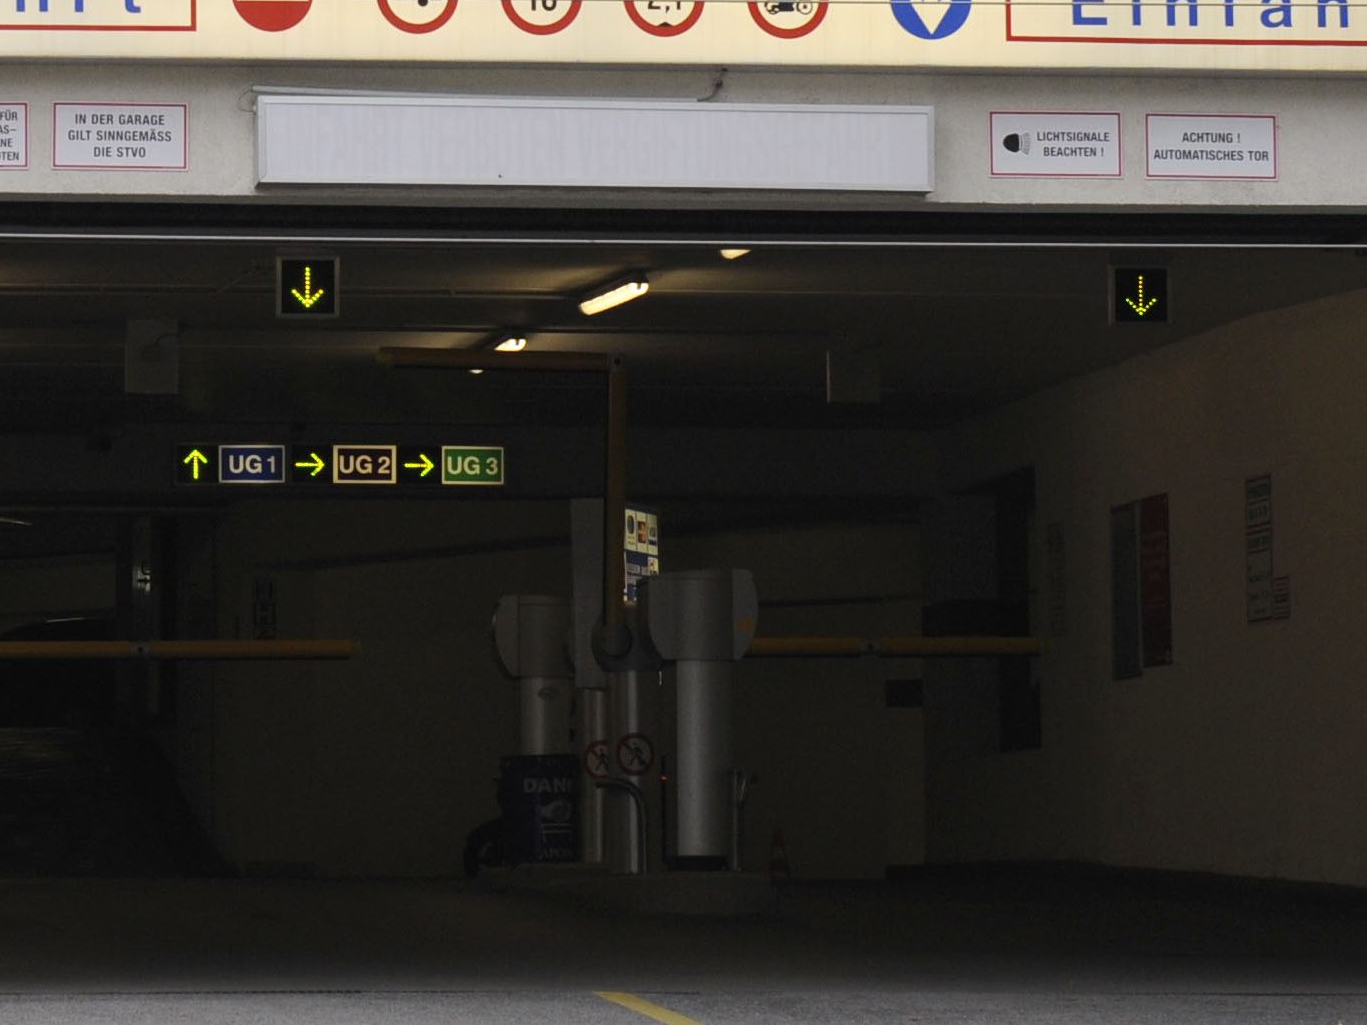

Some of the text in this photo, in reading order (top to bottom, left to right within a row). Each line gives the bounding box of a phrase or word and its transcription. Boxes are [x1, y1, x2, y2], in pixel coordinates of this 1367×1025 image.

[0, 110, 18, 122] FÜR
[75, 113, 165, 126] IN DER GARAGE
[68, 130, 172, 143] GILT SINNGEMÄSS
[1037, 132, 1110, 143] LICHTSIGNALE
[1182, 133, 1233, 144] ACHTUNG
[93, 147, 146, 158] DIE STVO
[1043, 147, 1097, 158] BEACHTEN
[1153, 149, 1269, 161] AUTOMATISCHES TOR
[228, 454, 262, 474] UG
[339, 455, 391, 474] UG 2
[447, 456, 498, 475] UG 3
